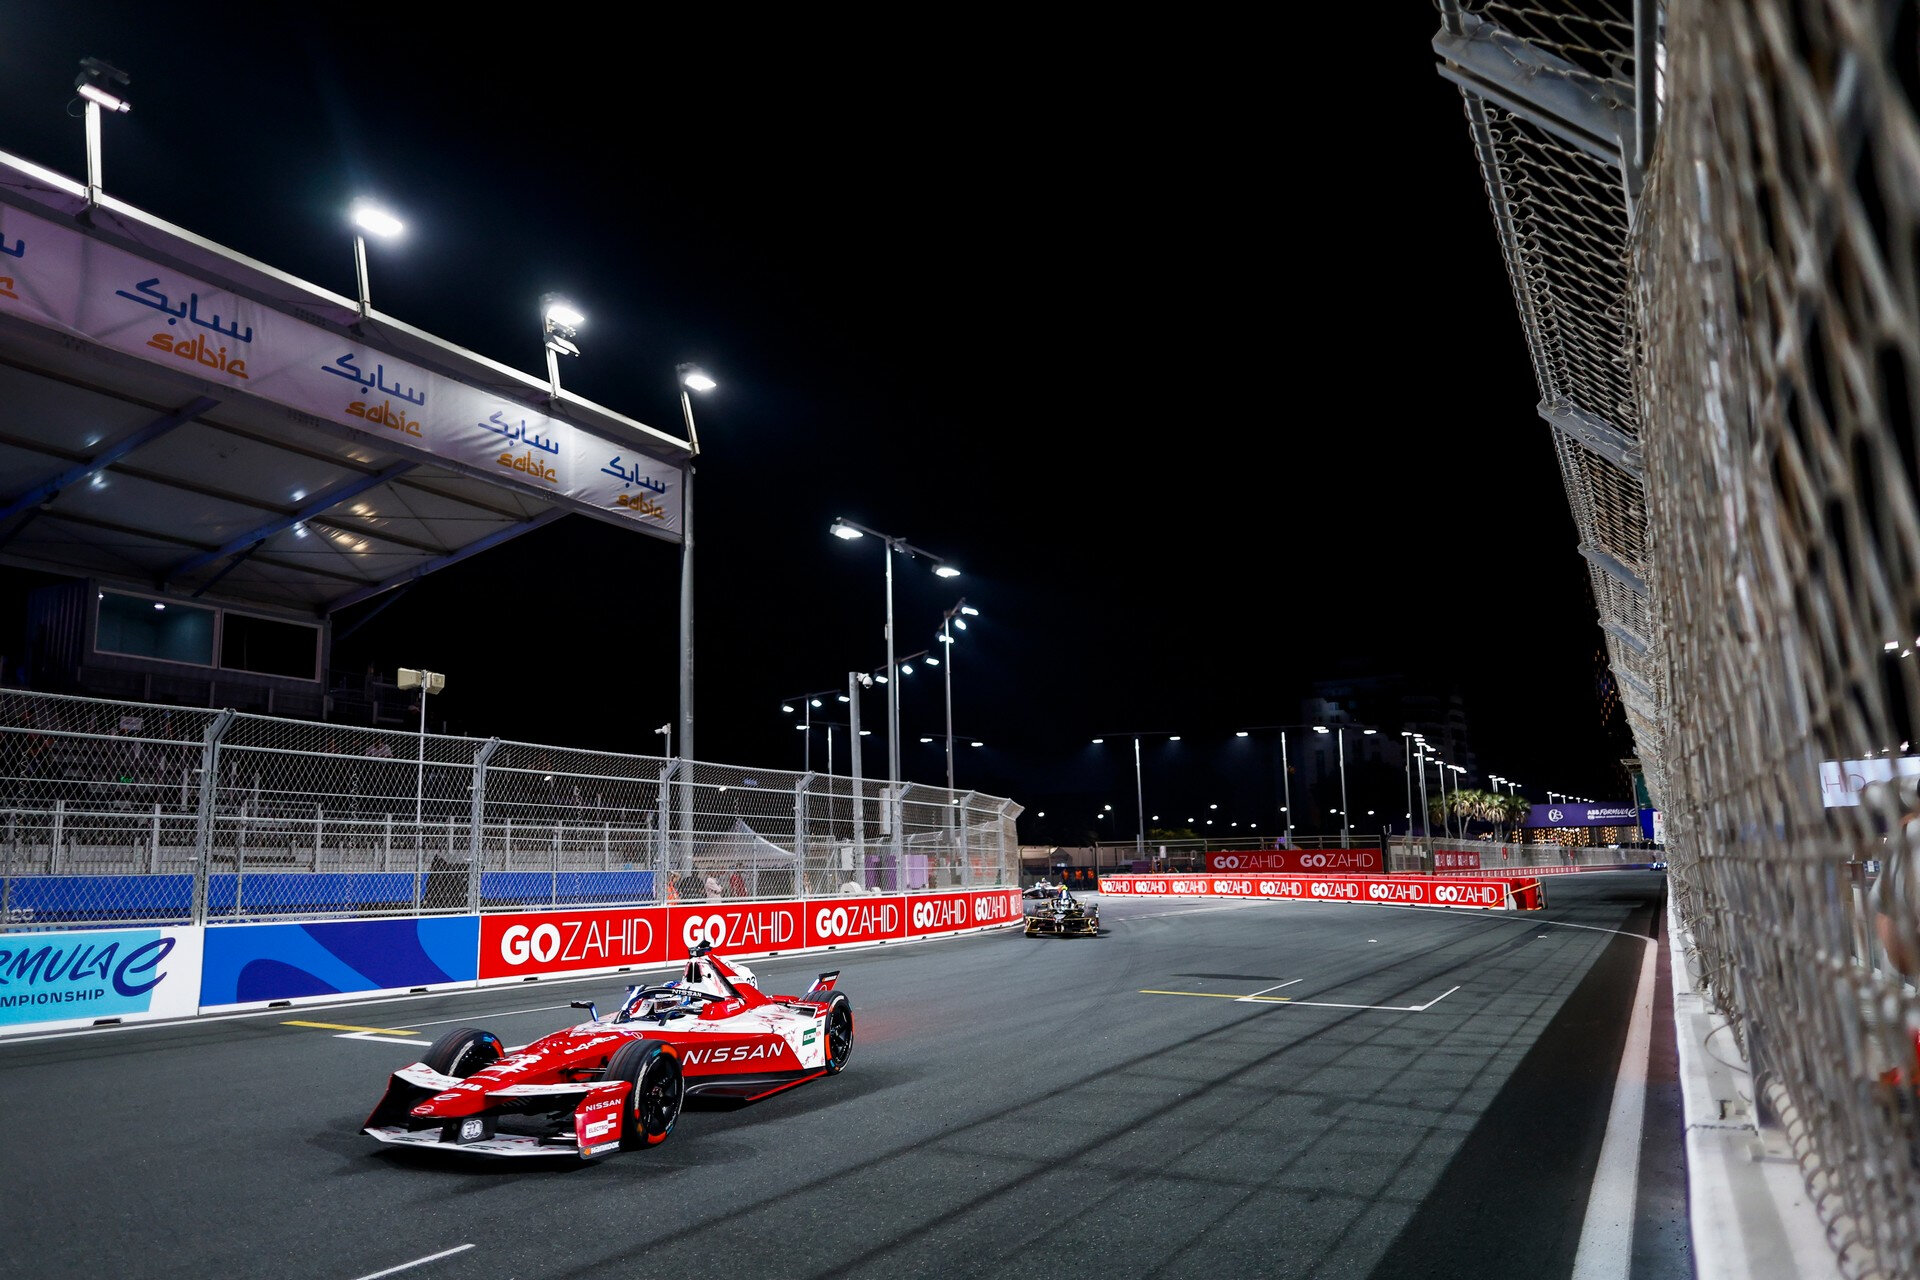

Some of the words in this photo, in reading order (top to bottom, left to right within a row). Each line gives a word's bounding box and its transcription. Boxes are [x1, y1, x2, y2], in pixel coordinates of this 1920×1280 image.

[147, 333, 249, 379] sabic
[345, 400, 422, 438] sabic
[496, 451, 558, 484] sabic
[616, 492, 665, 520] sabic
[1213, 854, 1285, 869] GOZAHID
[1300, 853, 1374, 868] GOZAHID
[1259, 880, 1302, 896] GOZAHID
[1310, 881, 1359, 899] GOZAHID
[1369, 883, 1423, 901] GOZAHID
[1435, 885, 1498, 904] GOZAHID
[913, 898, 966, 929] GOZAHID
[974, 895, 1008, 921] GOZAHID
[683, 910, 794, 950] GOZAHID
[815, 904, 898, 938] GOZAHID
[501, 917, 653, 965] GOZAHID
[671, 988, 702, 998] NISSAN
[682, 1041, 785, 1066] NISSAN
[585, 1098, 622, 1112] NISSAN
